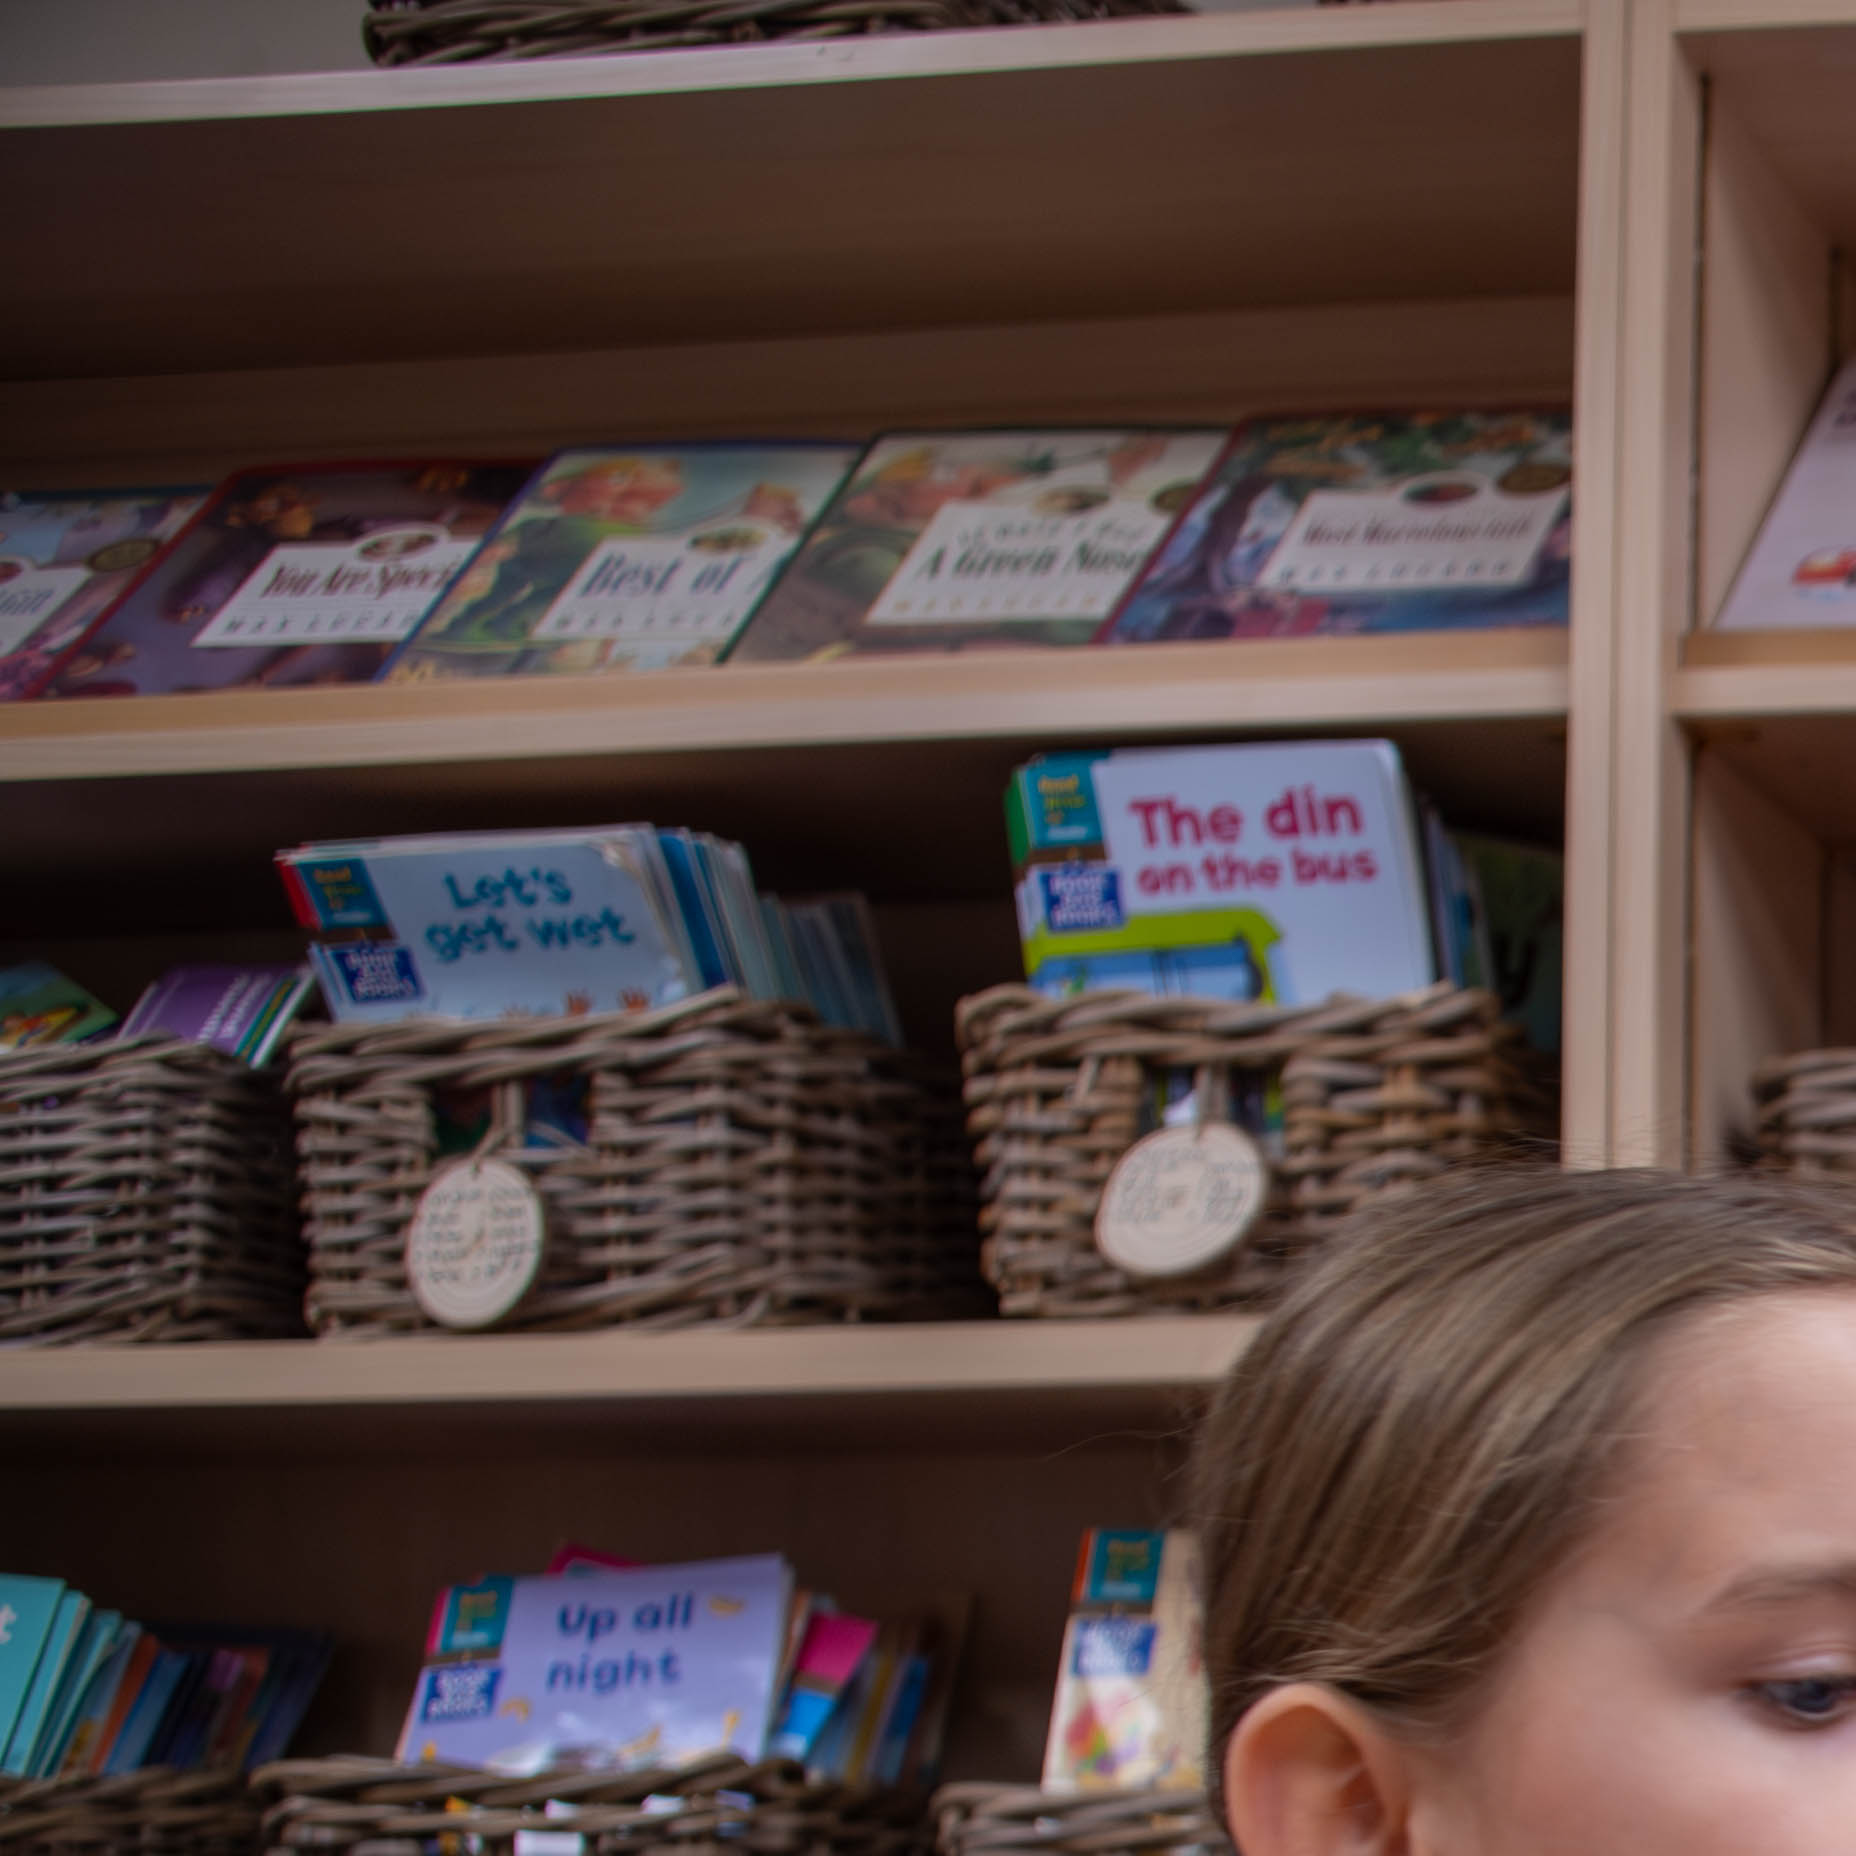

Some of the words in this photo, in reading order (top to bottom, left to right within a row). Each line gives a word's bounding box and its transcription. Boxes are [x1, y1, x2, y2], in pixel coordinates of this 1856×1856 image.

[262, 567, 314, 599] You
[319, 561, 370, 597] Are
[368, 554, 459, 600] Speci
[582, 552, 683, 598] Best
[691, 552, 736, 596] of
[914, 545, 943, 582] A
[956, 541, 1051, 580] Green
[1128, 795, 1244, 849] The
[1263, 781, 1363, 839] din
[444, 866, 575, 910] Let's
[1138, 863, 1193, 896] on
[1205, 848, 1280, 890] the
[1291, 842, 1379, 886] bus
[427, 912, 519, 961] get
[536, 904, 636, 950] wet
[556, 1600, 616, 1643] Up
[633, 1592, 693, 1633] all
[546, 1649, 682, 1698] night
